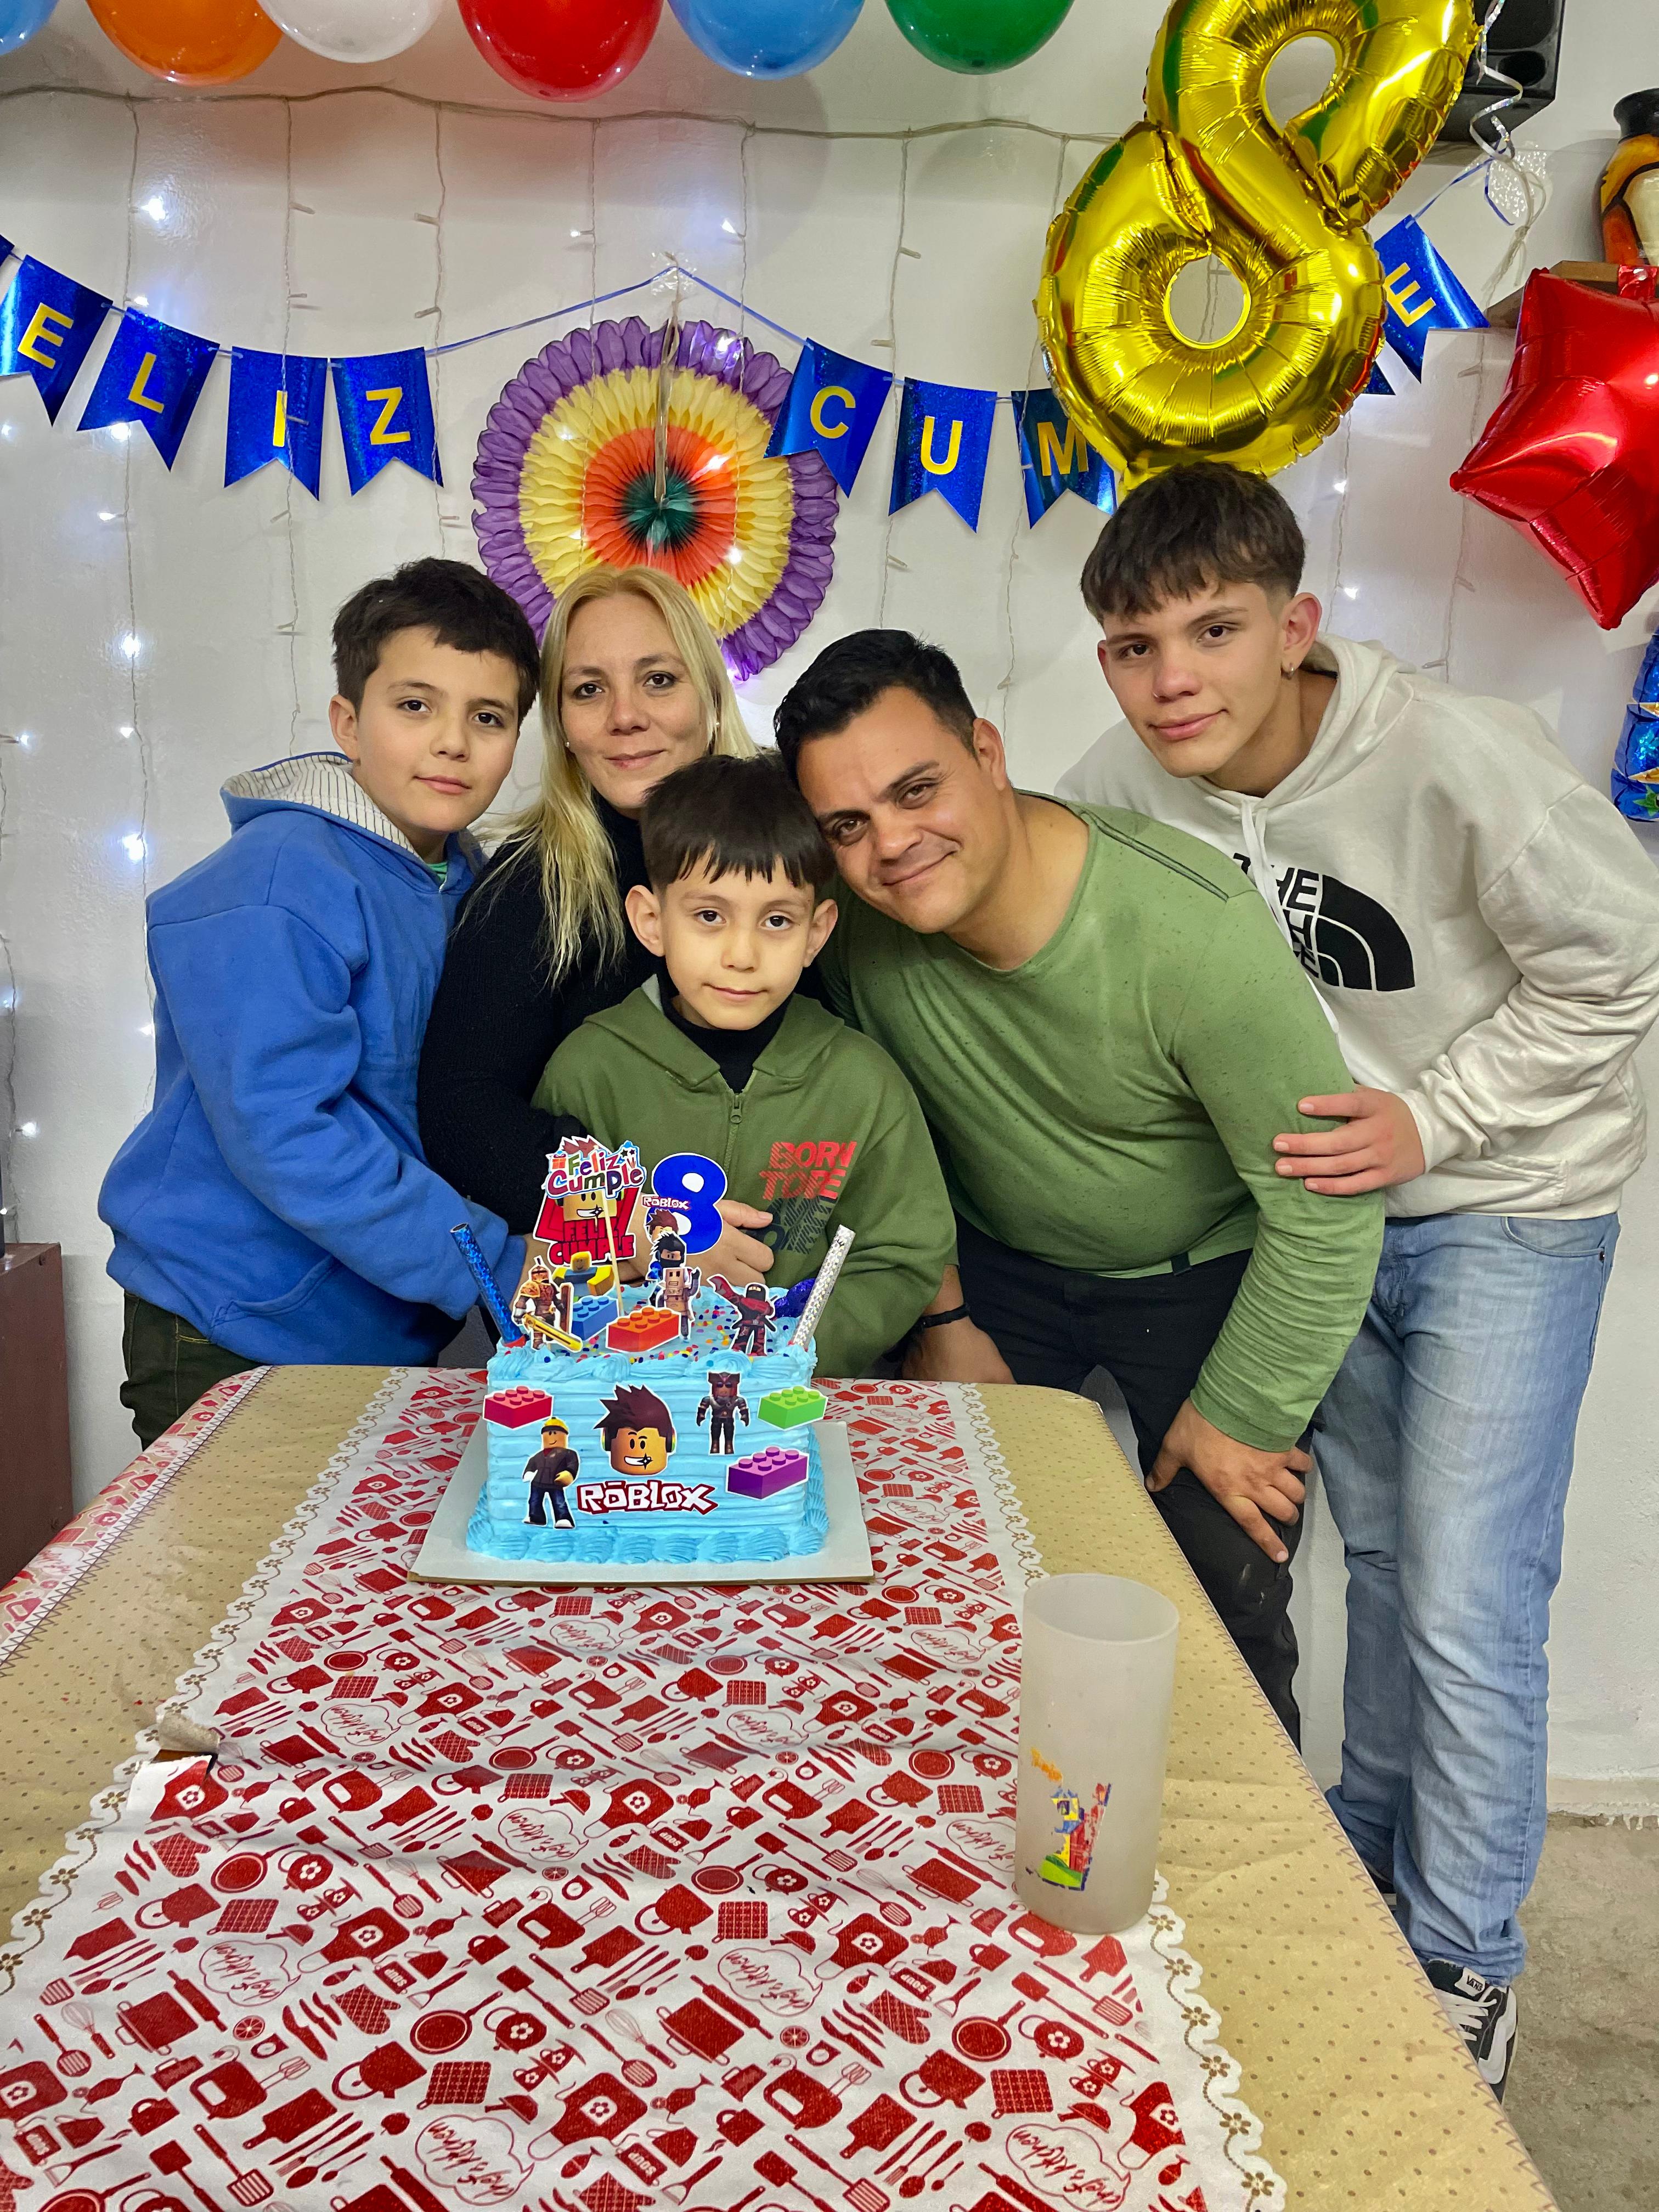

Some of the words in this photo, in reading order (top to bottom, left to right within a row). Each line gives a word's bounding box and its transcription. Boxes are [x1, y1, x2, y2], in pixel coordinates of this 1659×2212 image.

[568, 1152, 620, 1176] Feliz
[548, 1163, 644, 1195] Cumple
[646, 1152, 727, 1255] 8
[659, 1832, 681, 1846] SOUP
[385, 1968, 407, 1987] SOUP
[900, 1974, 927, 1993] SOUP
[1466, 1975, 1483, 1991] VANS
[628, 2152, 657, 2176] SOUP
